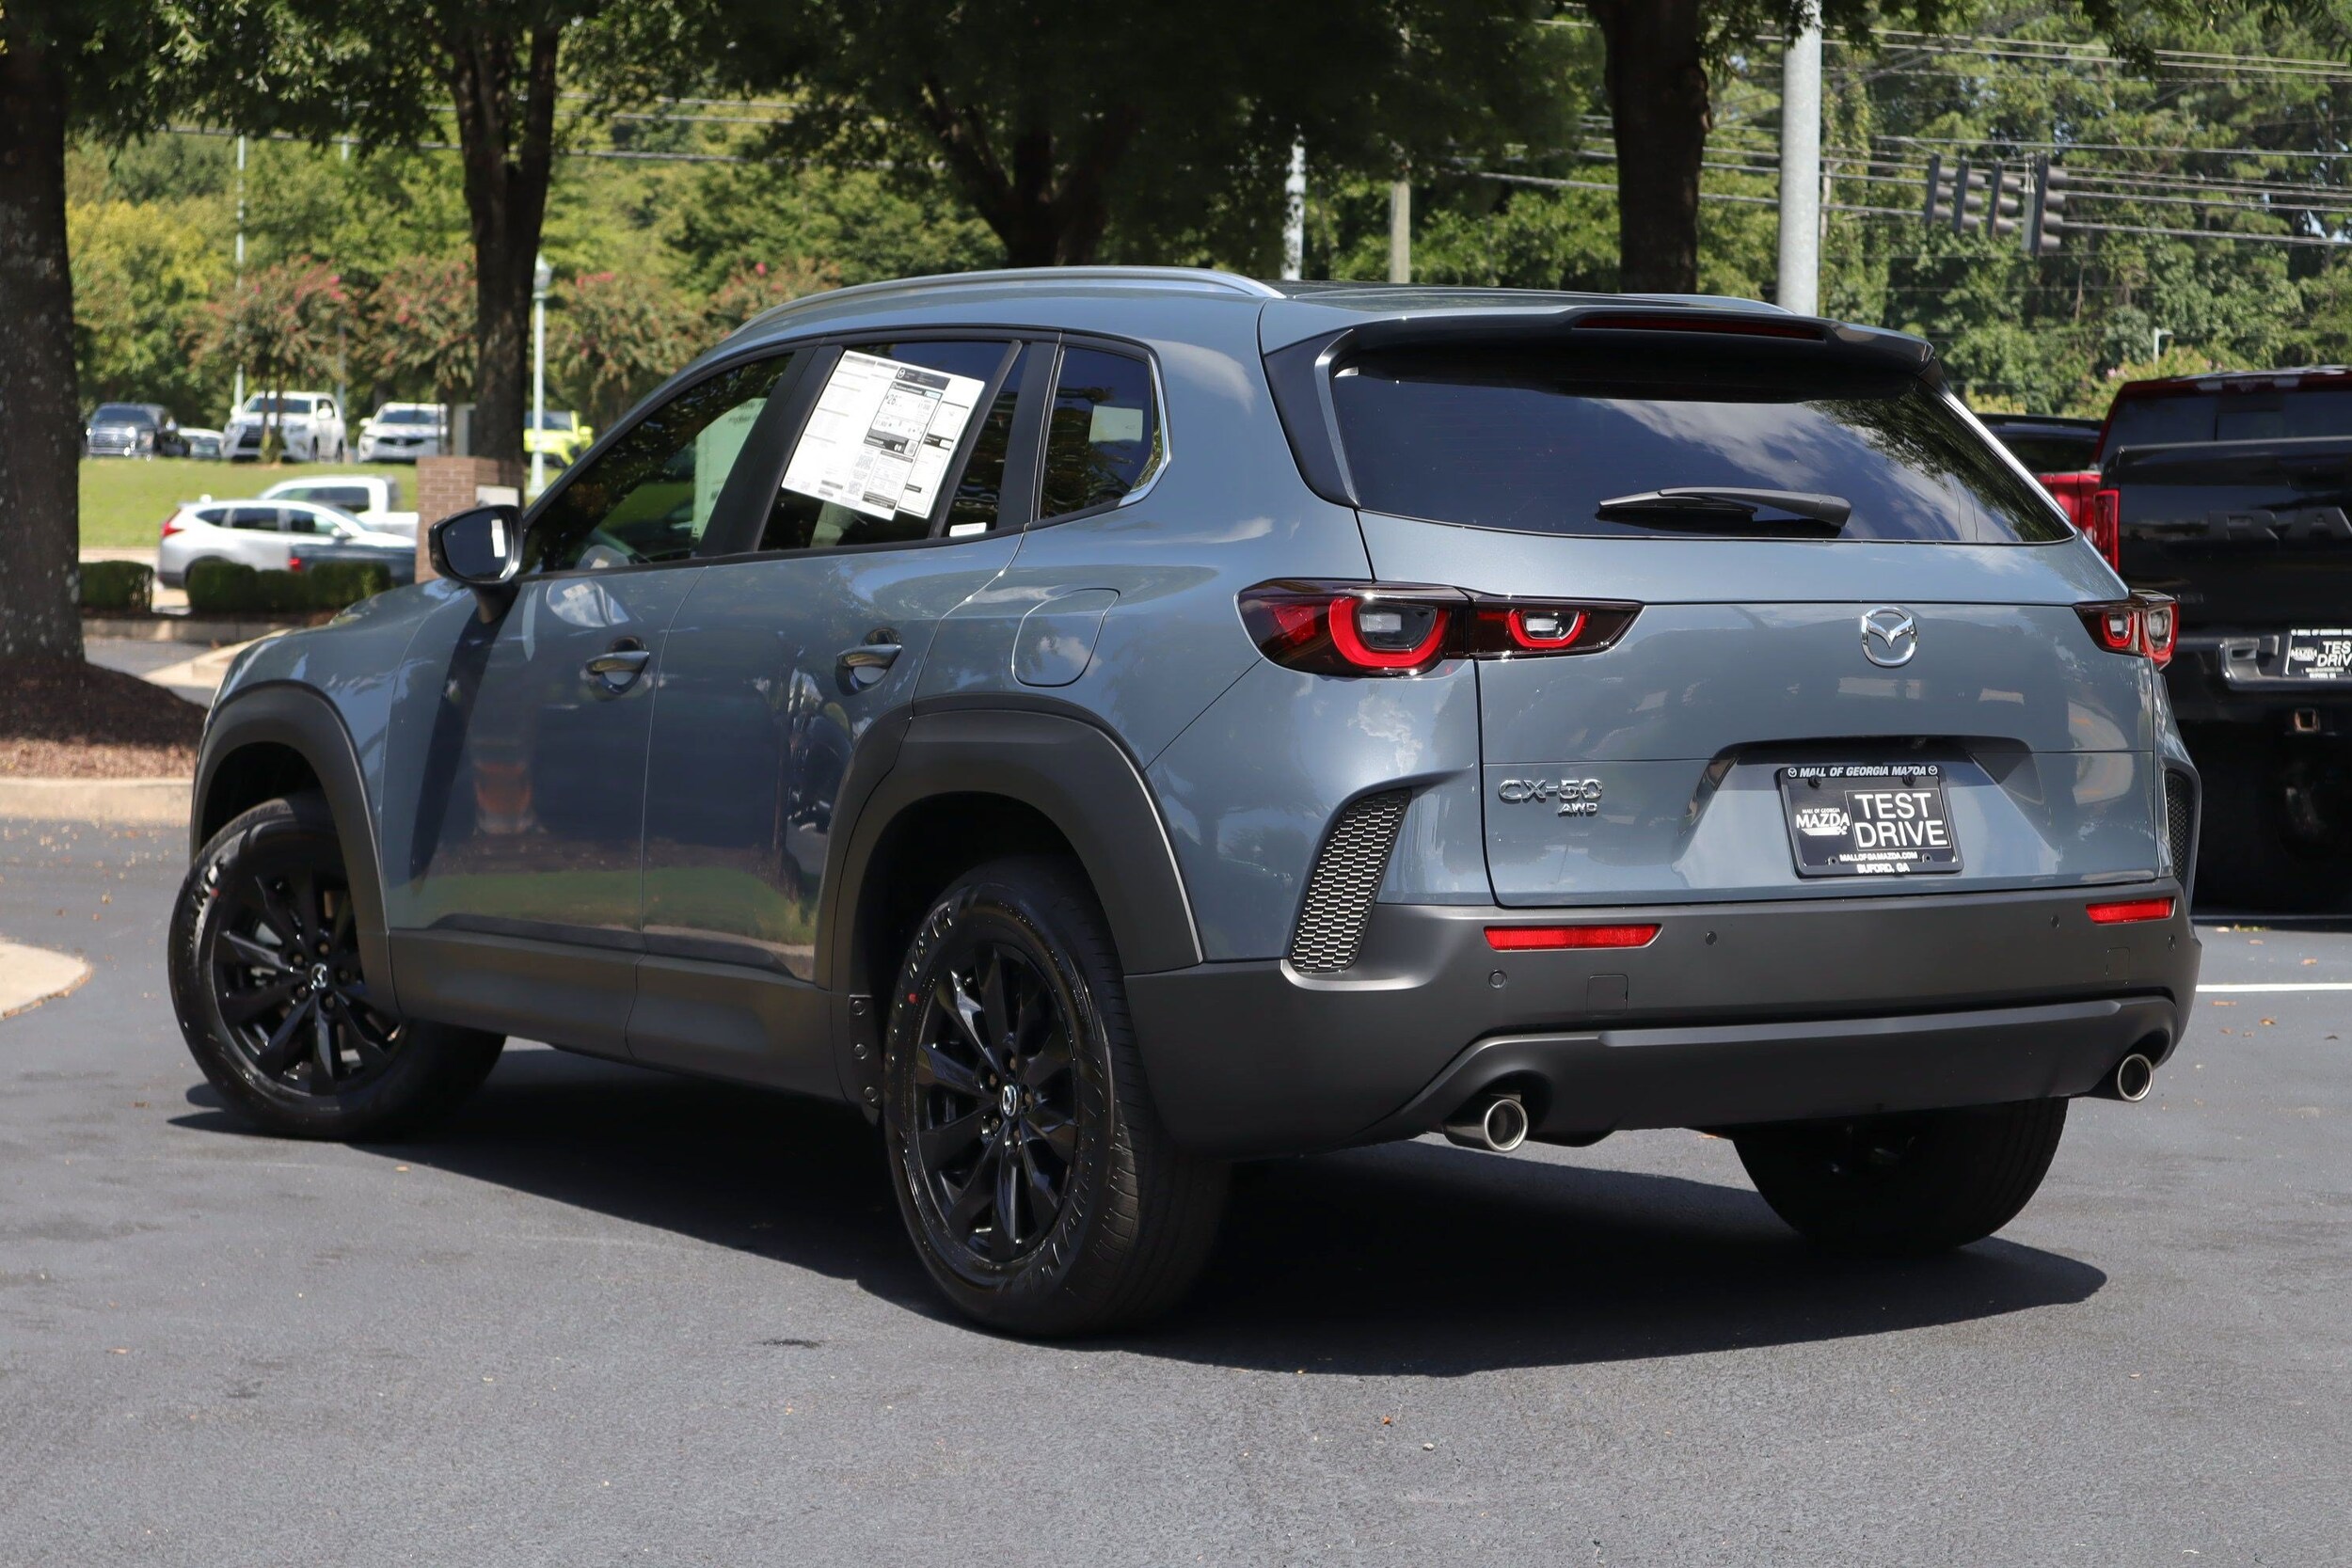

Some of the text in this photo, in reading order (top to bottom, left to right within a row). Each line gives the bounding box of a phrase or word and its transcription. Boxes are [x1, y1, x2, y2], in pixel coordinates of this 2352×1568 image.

[2209, 506, 2352, 541] RA
[2322, 641, 2352, 655] TES
[2317, 654, 2352, 667] DRIV
[1800, 766, 1926, 778] MALL OF GEORGIA MAZDA
[1499, 778, 1604, 801] CX-50
[1558, 802, 1597, 816] AWD
[1854, 792, 1931, 819] TEST
[1796, 813, 1851, 828] MAZDA
[1854, 820, 1947, 847] DRIVE
[1839, 851, 1918, 862] MALLOFGAMAZDA.COM
[1897, 863, 1911, 873] GA
